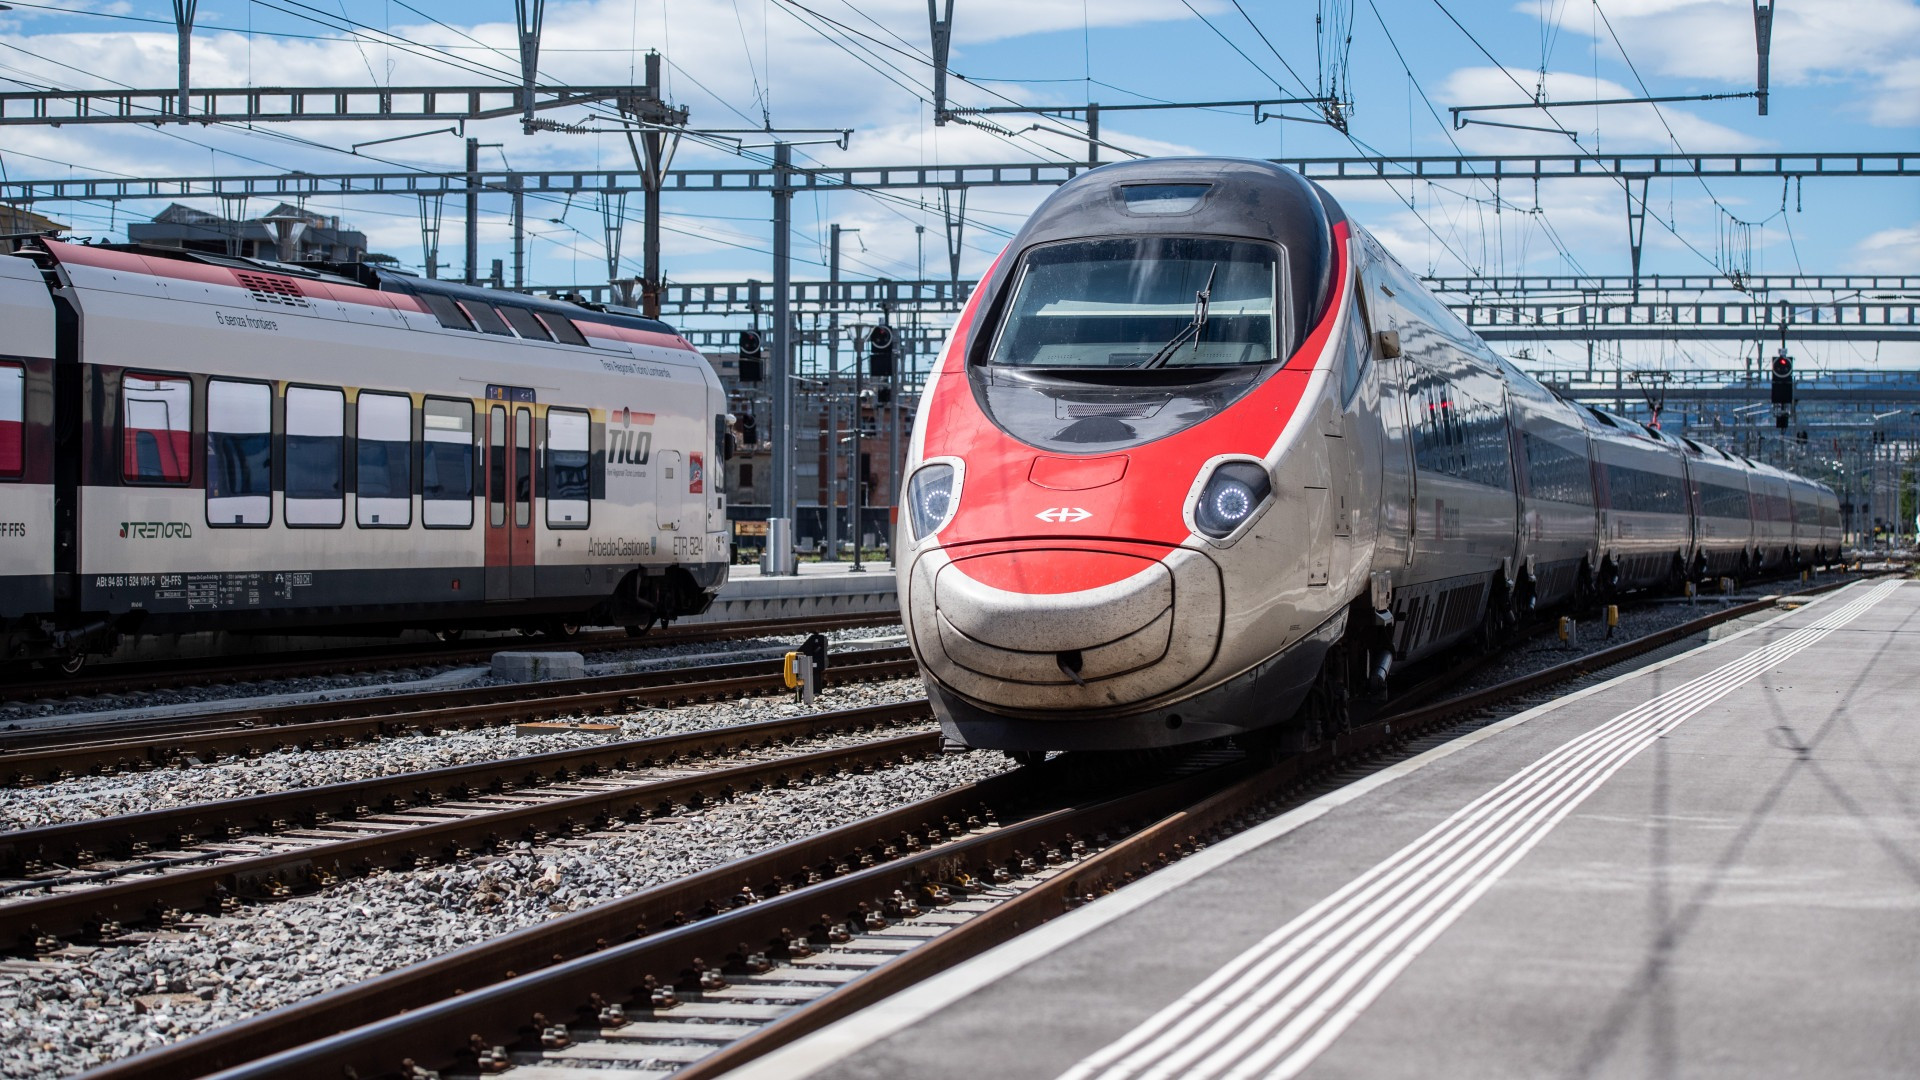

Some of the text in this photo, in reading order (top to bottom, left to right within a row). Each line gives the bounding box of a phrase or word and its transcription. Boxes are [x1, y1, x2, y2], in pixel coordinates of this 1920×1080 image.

[225, 315, 247, 327] senza
[246, 314, 278, 331] frontiere
[608, 407, 653, 465] TILO
[477, 437, 483, 466] 1
[538, 441, 544, 469] 1
[9, 522, 25, 537] FFS
[130, 522, 192, 539] TRENORD
[588, 537, 650, 556] Arbedo-Castione
[673, 536, 703, 555] ETR 524
[96, 576, 107, 587] ABt
[108, 576, 116, 587] 94
[116, 576, 124, 587] 85
[124, 576, 128, 587] 1
[129, 576, 139, 587] 524
[140, 576, 155, 586] 101-6
[160, 575, 182, 587] CH-FFS
